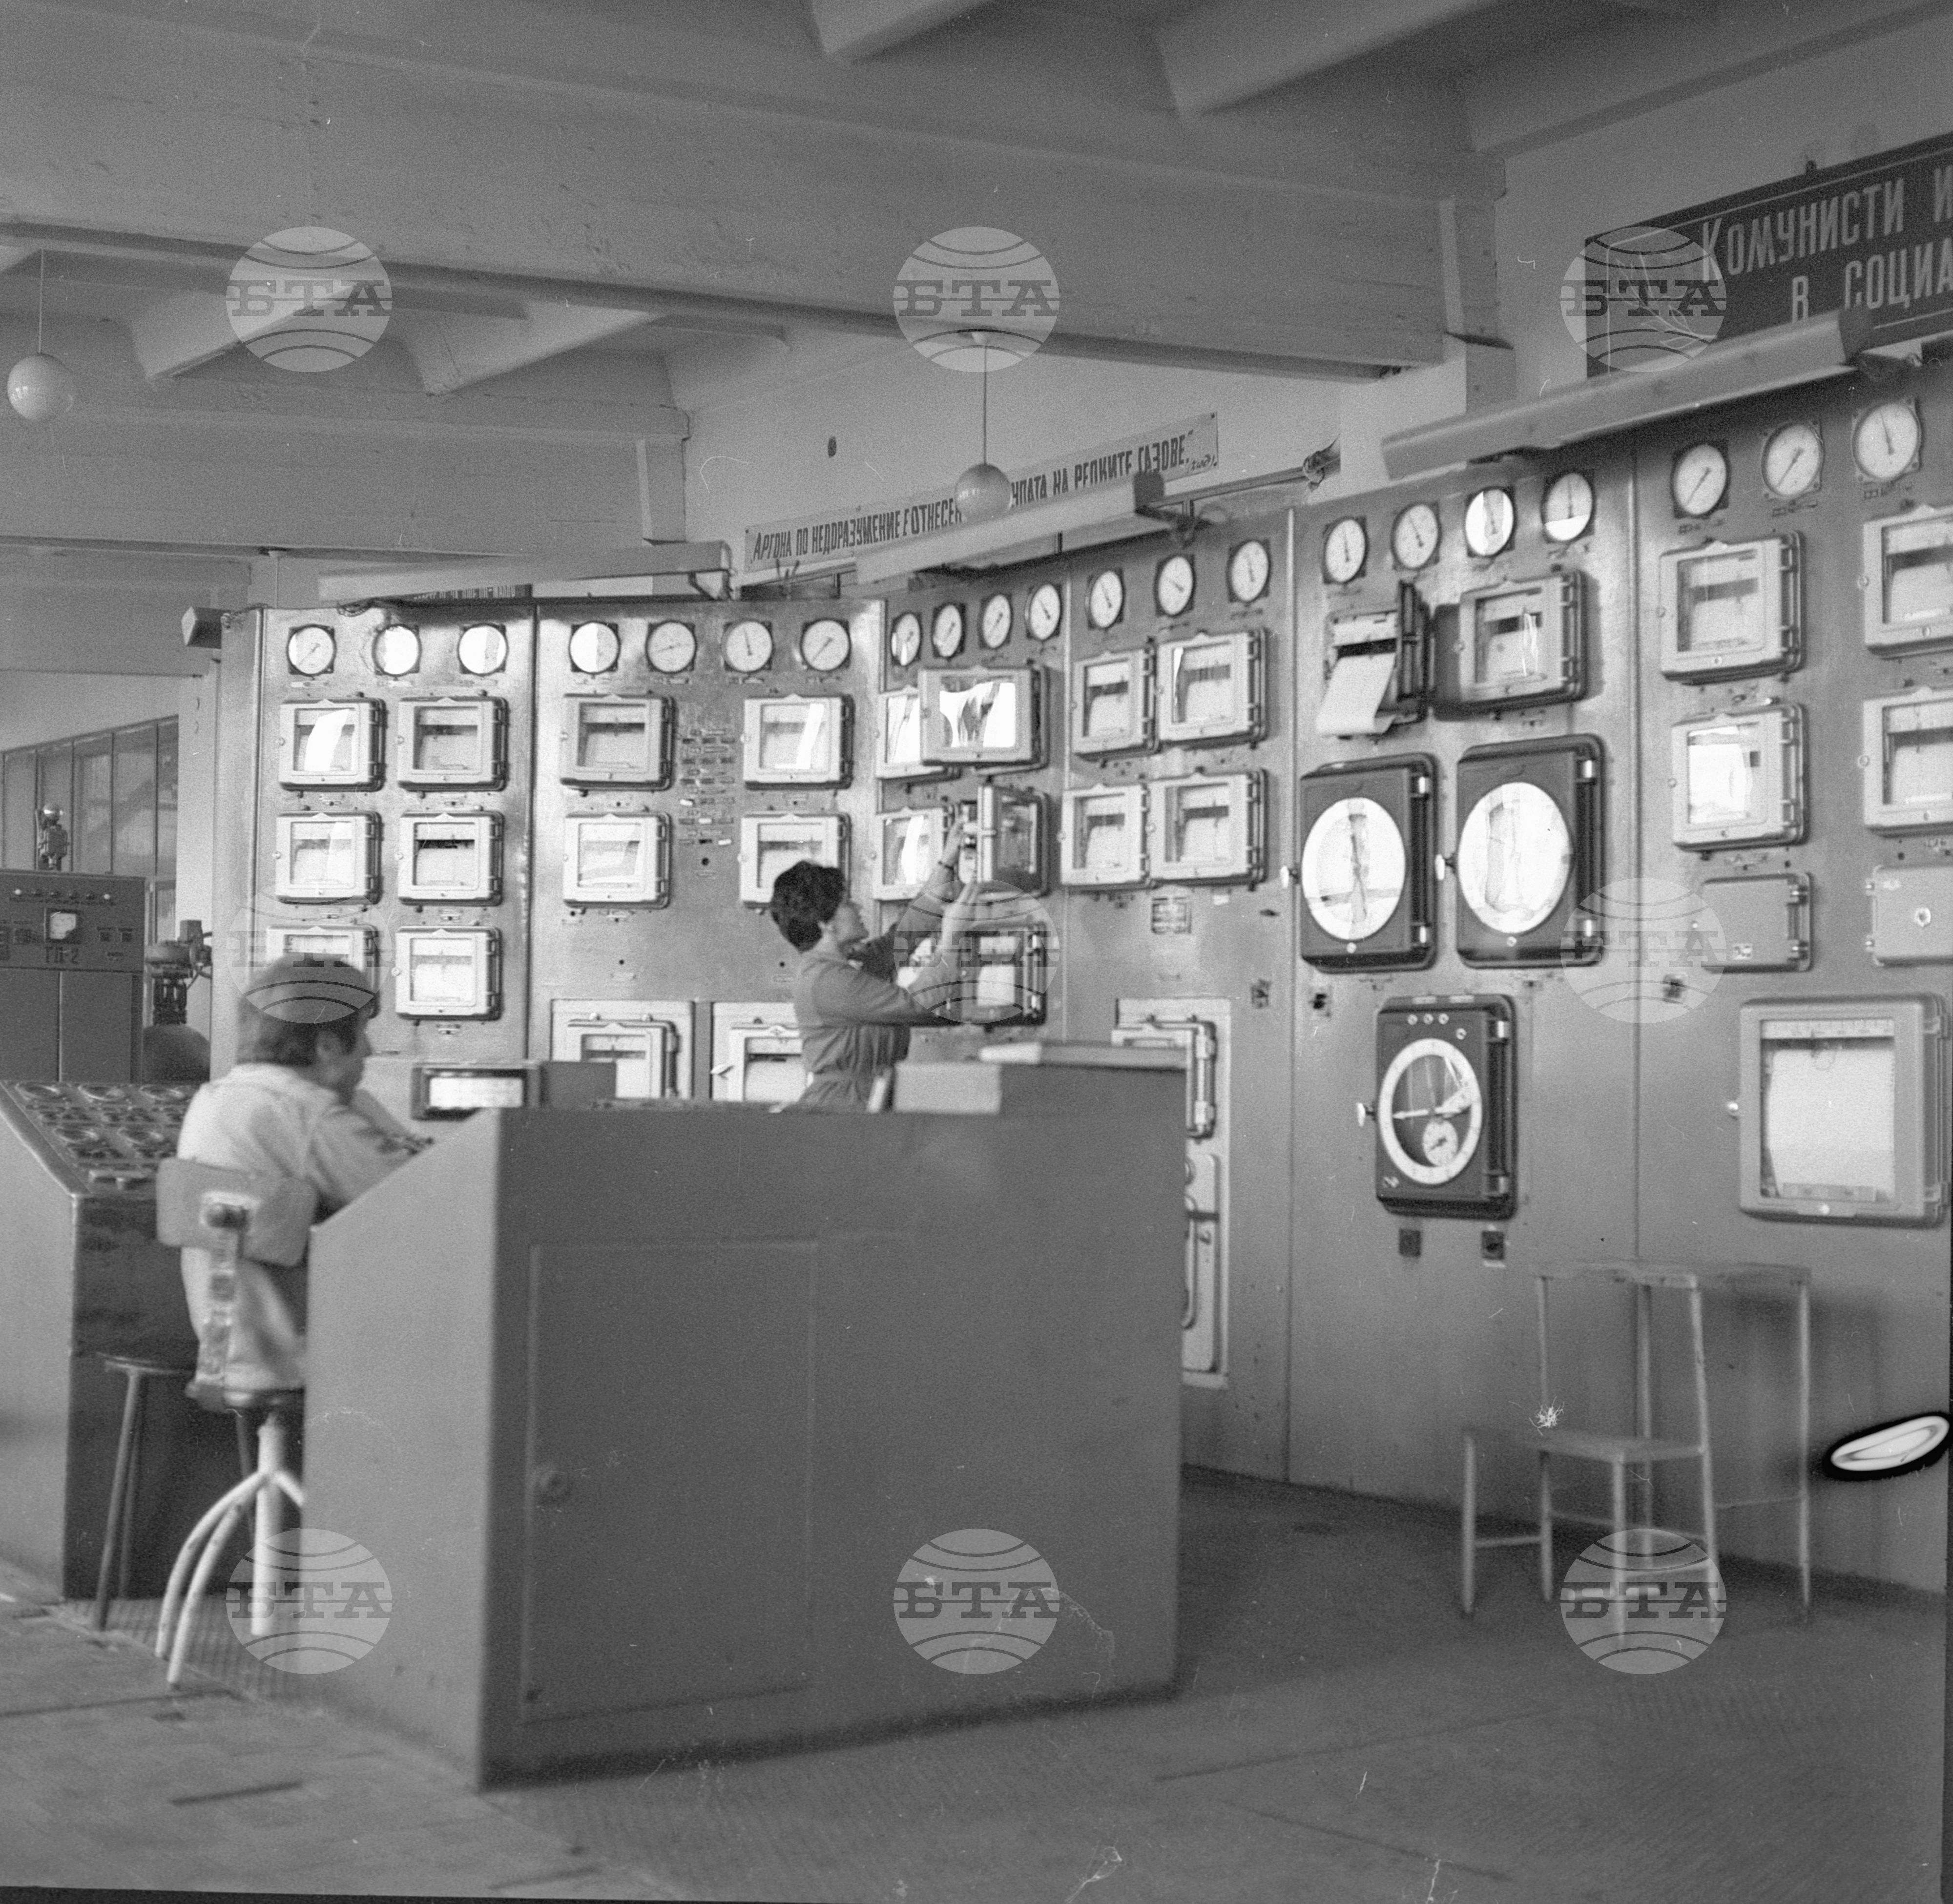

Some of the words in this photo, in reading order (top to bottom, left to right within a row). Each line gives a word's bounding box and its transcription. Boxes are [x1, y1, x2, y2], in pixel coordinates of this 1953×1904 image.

[1702, 177, 1904, 283] КОМУНИСТИ
[796, 527, 809, 556] ПО
[811, 510, 900, 555] НЕДОРАЗУМЕНИЕ
[902, 508, 910, 536] Е
[1053, 468, 1069, 496] НА
